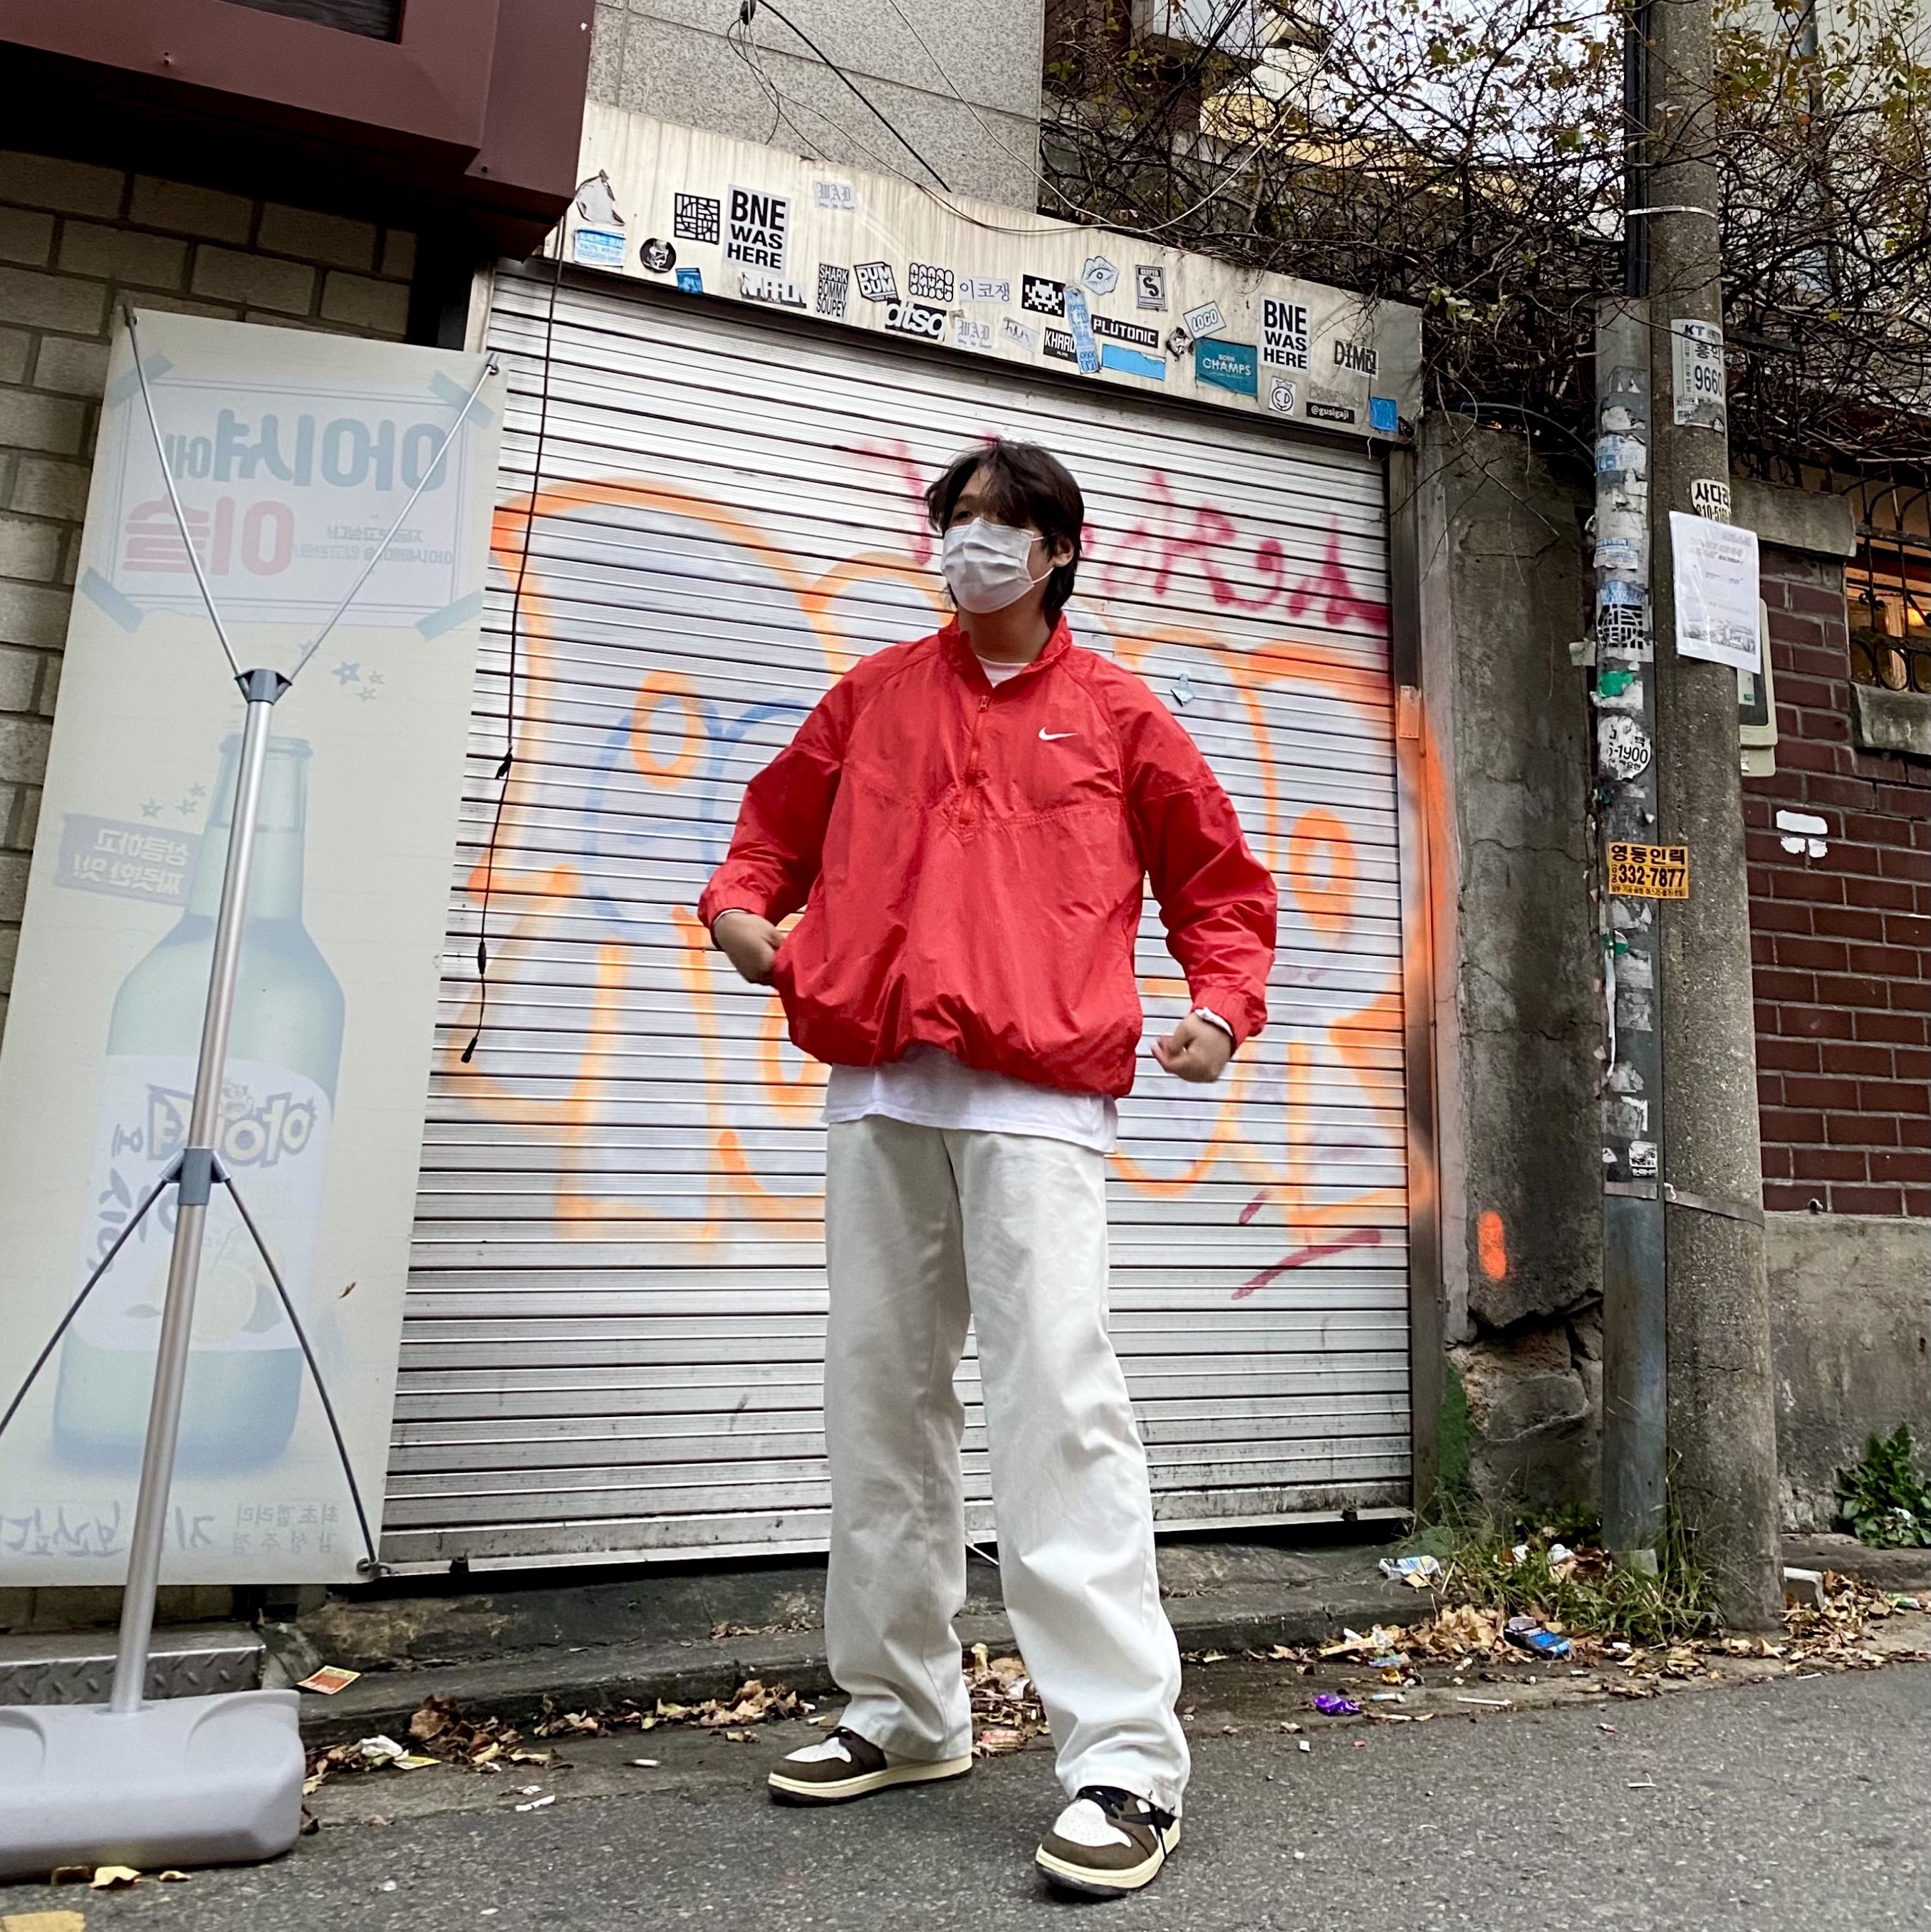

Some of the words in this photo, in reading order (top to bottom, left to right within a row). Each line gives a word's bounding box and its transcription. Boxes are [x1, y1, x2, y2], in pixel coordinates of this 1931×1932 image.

[732, 189, 786, 232] BNE
[730, 224, 784, 250] WAS
[727, 242, 783, 269] HERE
[819, 264, 849, 284] SHARK
[856, 266, 892, 282] DUM
[860, 278, 896, 294] DUM
[1143, 276, 1160, 297] S
[816, 296, 847, 318] SOUPEY
[1264, 299, 1307, 335] BNE
[1093, 318, 1156, 345] PLUTONIC
[1265, 330, 1307, 352] WAS
[1685, 324, 1705, 336] KT
[1202, 358, 1251, 376] CHAMPS
[1264, 347, 1308, 370] HERE
[1695, 365, 1723, 398] 9660
[1311, 405, 1349, 420] @gusigaji
[1611, 845, 1685, 866] 영동인력
[1618, 863, 1686, 888] 332-7877
